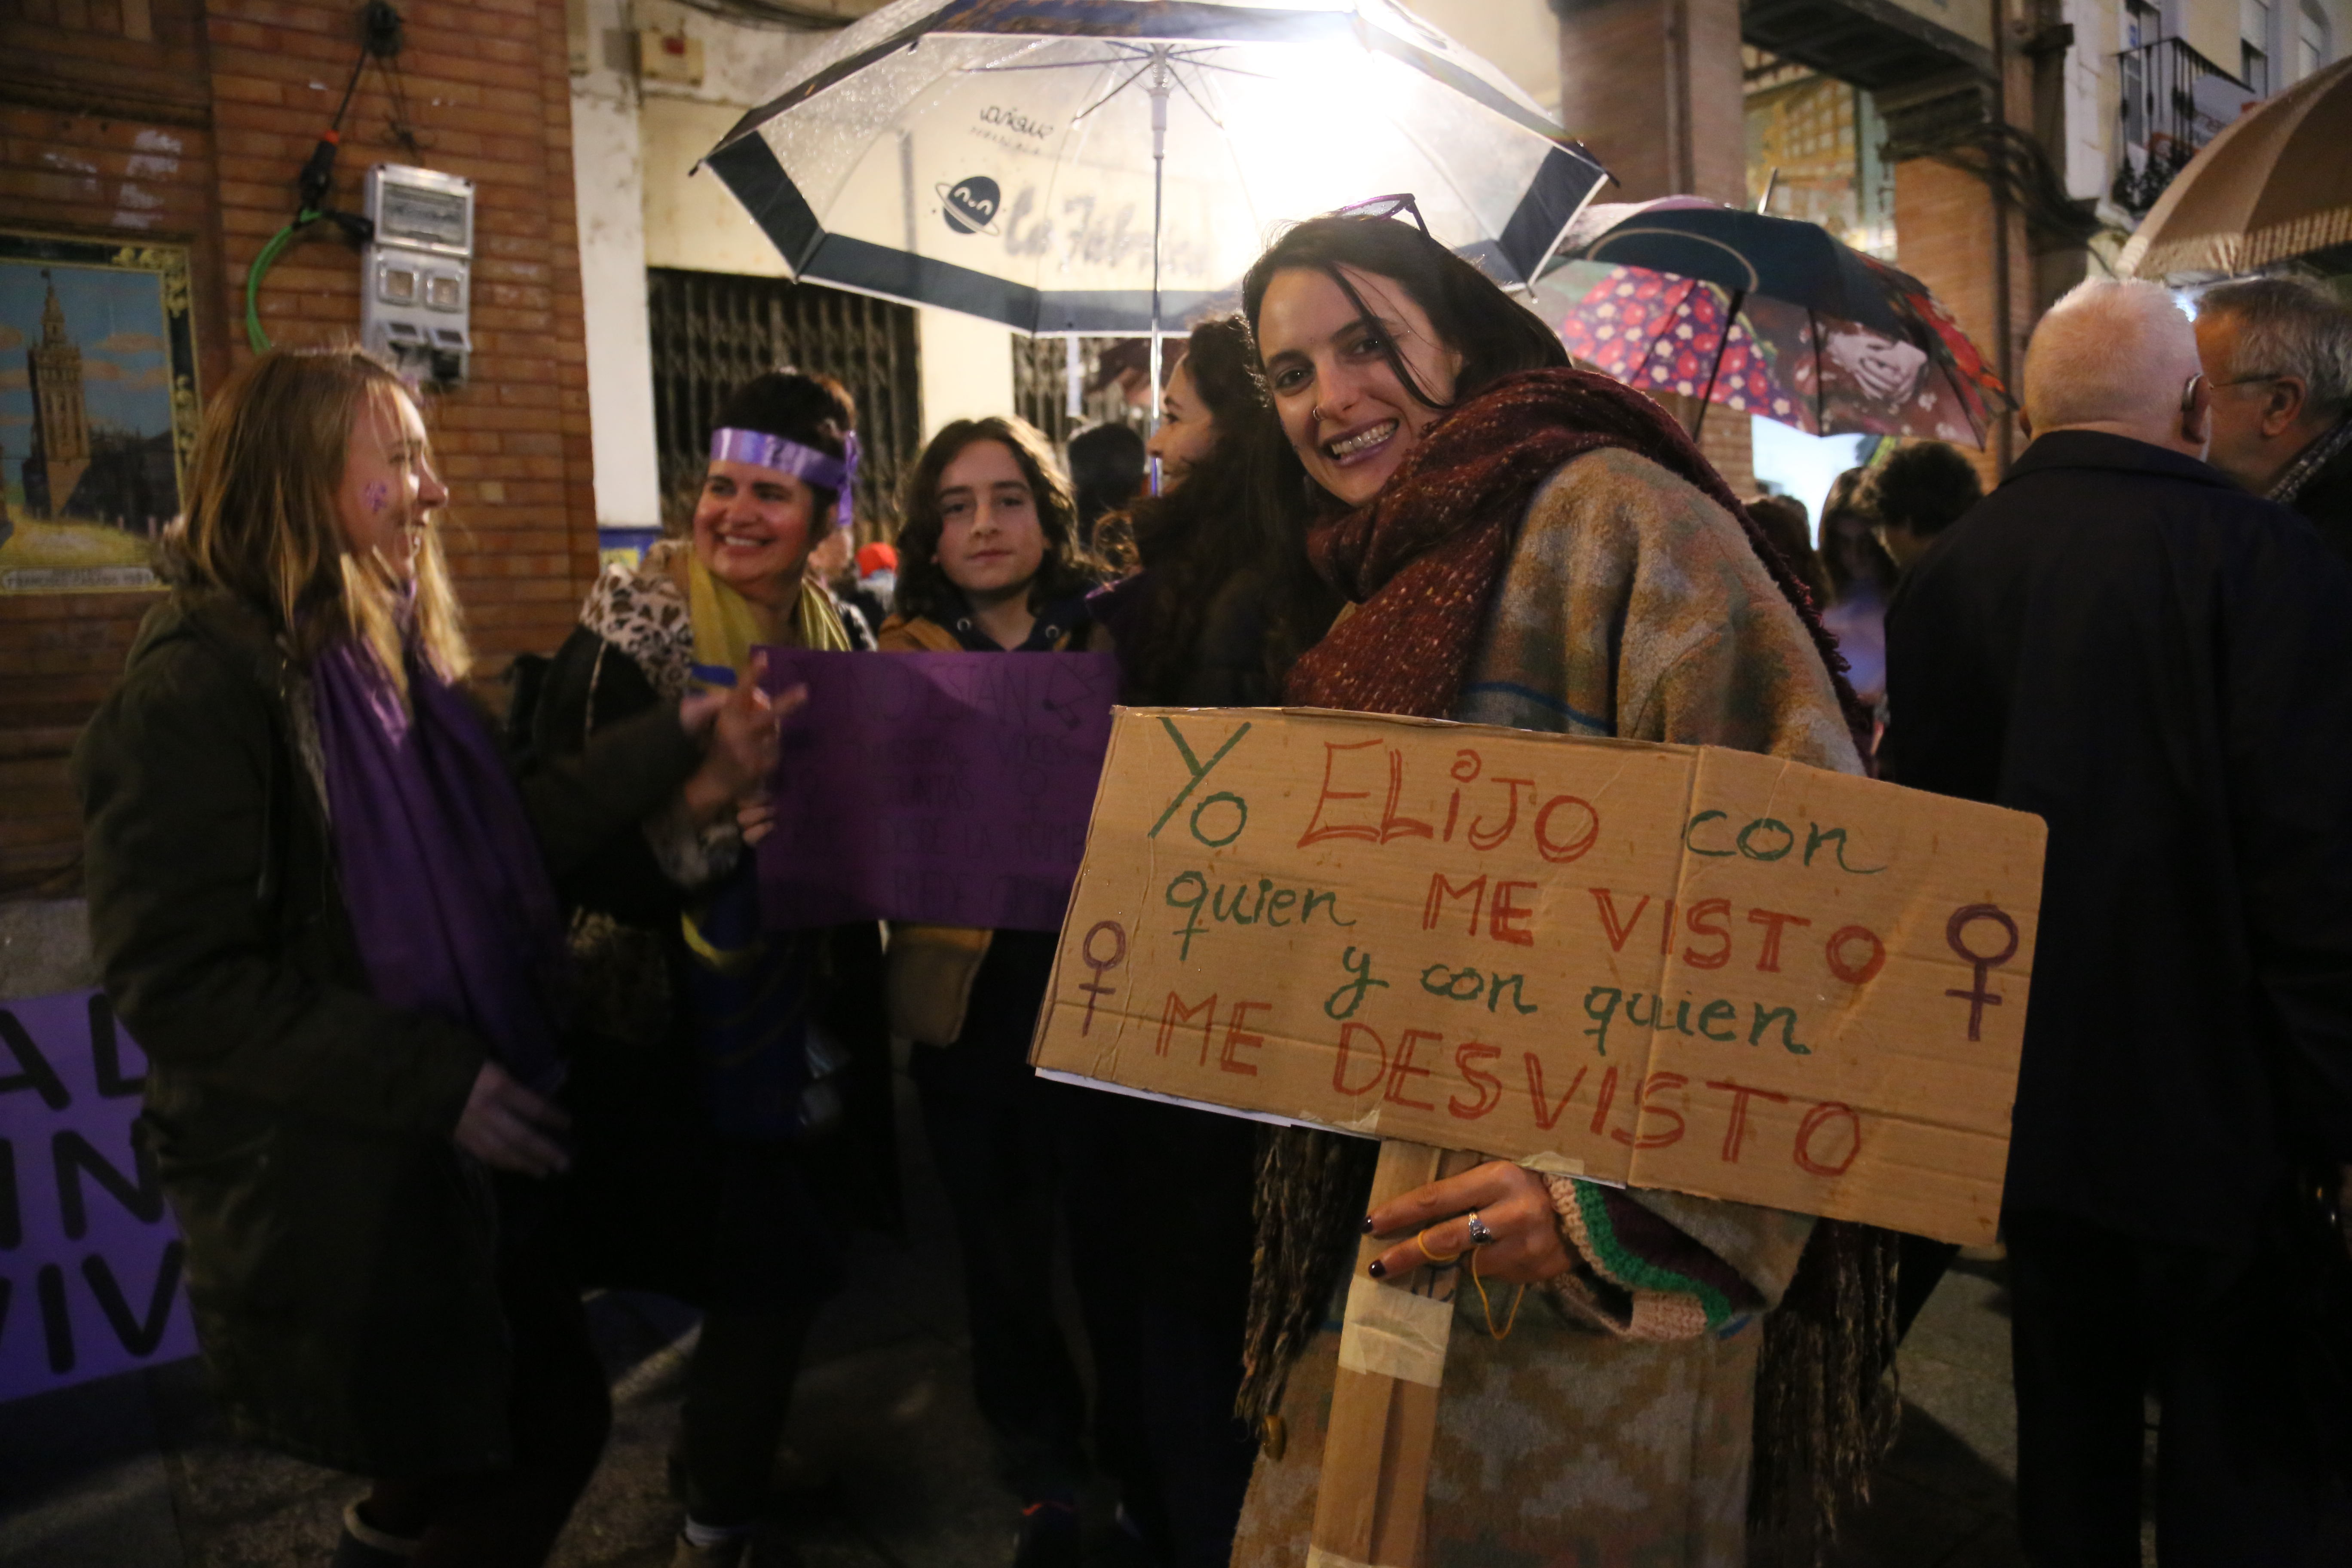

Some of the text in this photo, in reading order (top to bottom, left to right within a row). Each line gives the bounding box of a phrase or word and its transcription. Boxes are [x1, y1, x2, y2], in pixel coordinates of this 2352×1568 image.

[1149, 717, 1251, 847] Yo
[1685, 810, 1887, 873] con
[1166, 871, 1886, 983] quien ME VISTO
[1324, 946, 1811, 1055] y con quien
[1157, 994, 1862, 1177] ME DESVISTO
